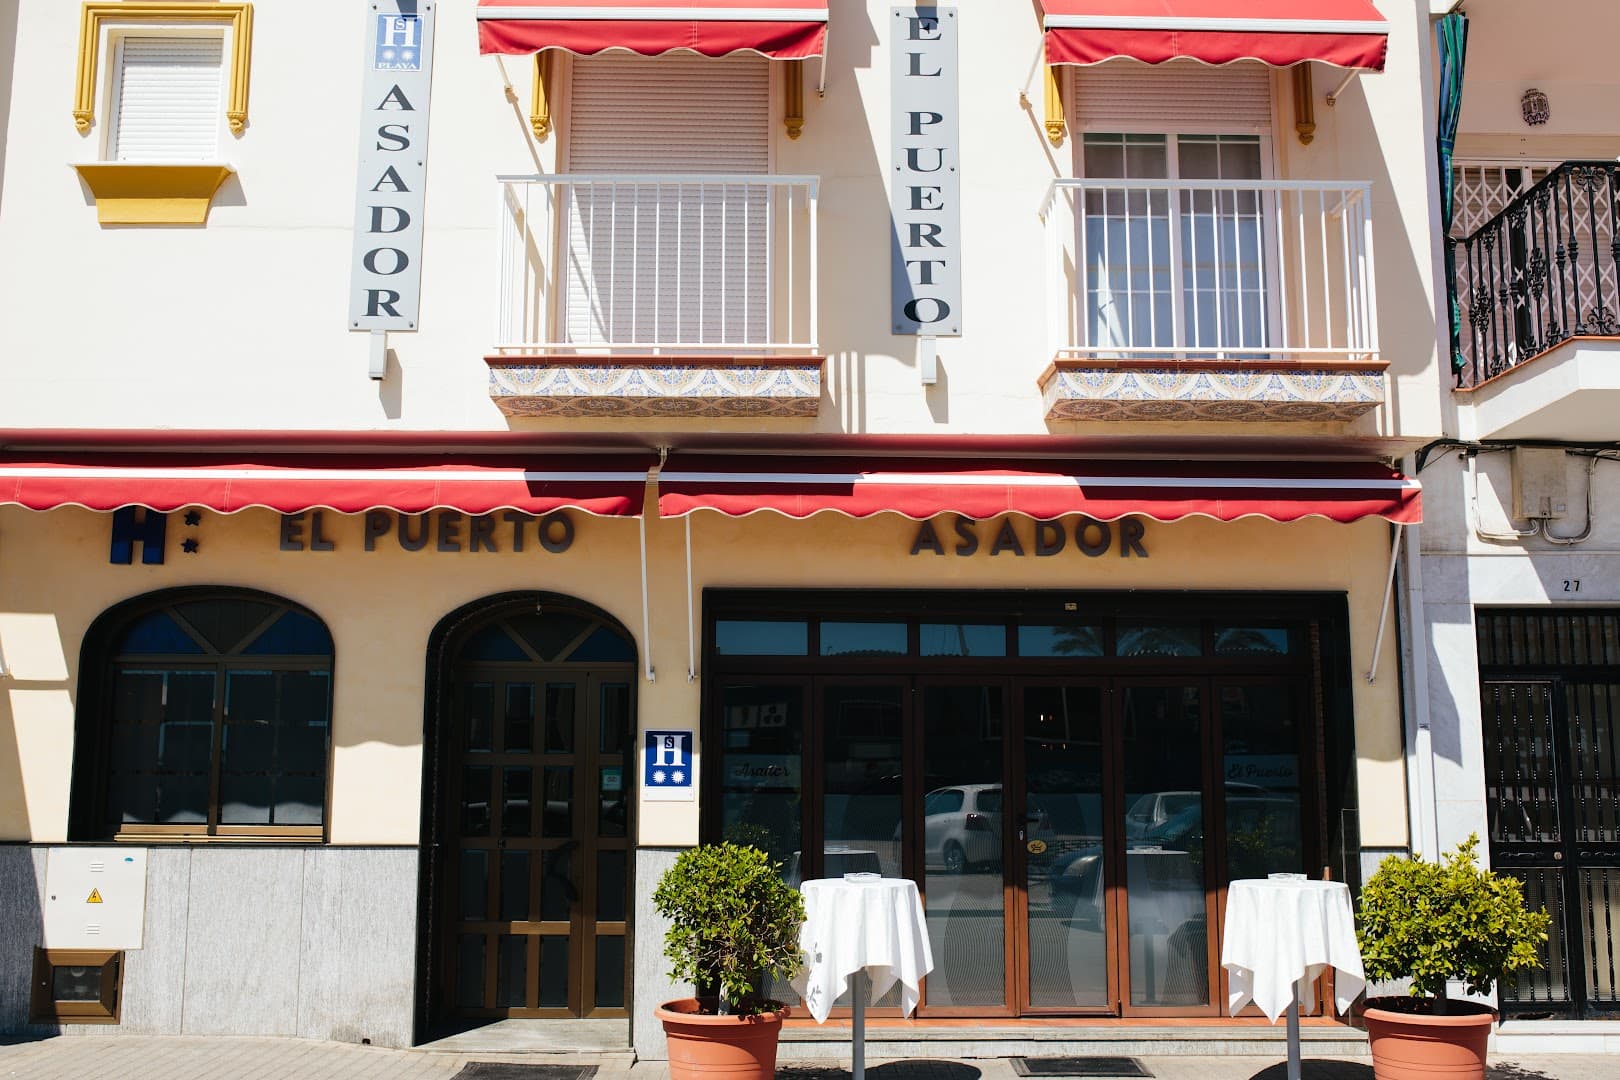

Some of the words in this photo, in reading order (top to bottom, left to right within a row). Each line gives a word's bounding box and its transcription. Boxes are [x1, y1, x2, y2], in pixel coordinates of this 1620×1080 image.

[904, 16, 943, 77] EL
[362, 84, 417, 318] ASADOR
[903, 111, 951, 324] PUERTO
[279, 511, 335, 552] EL
[365, 508, 575, 554] PUERTO
[909, 516, 1149, 558] ASADOR
[1563, 580, 1580, 592] 27
